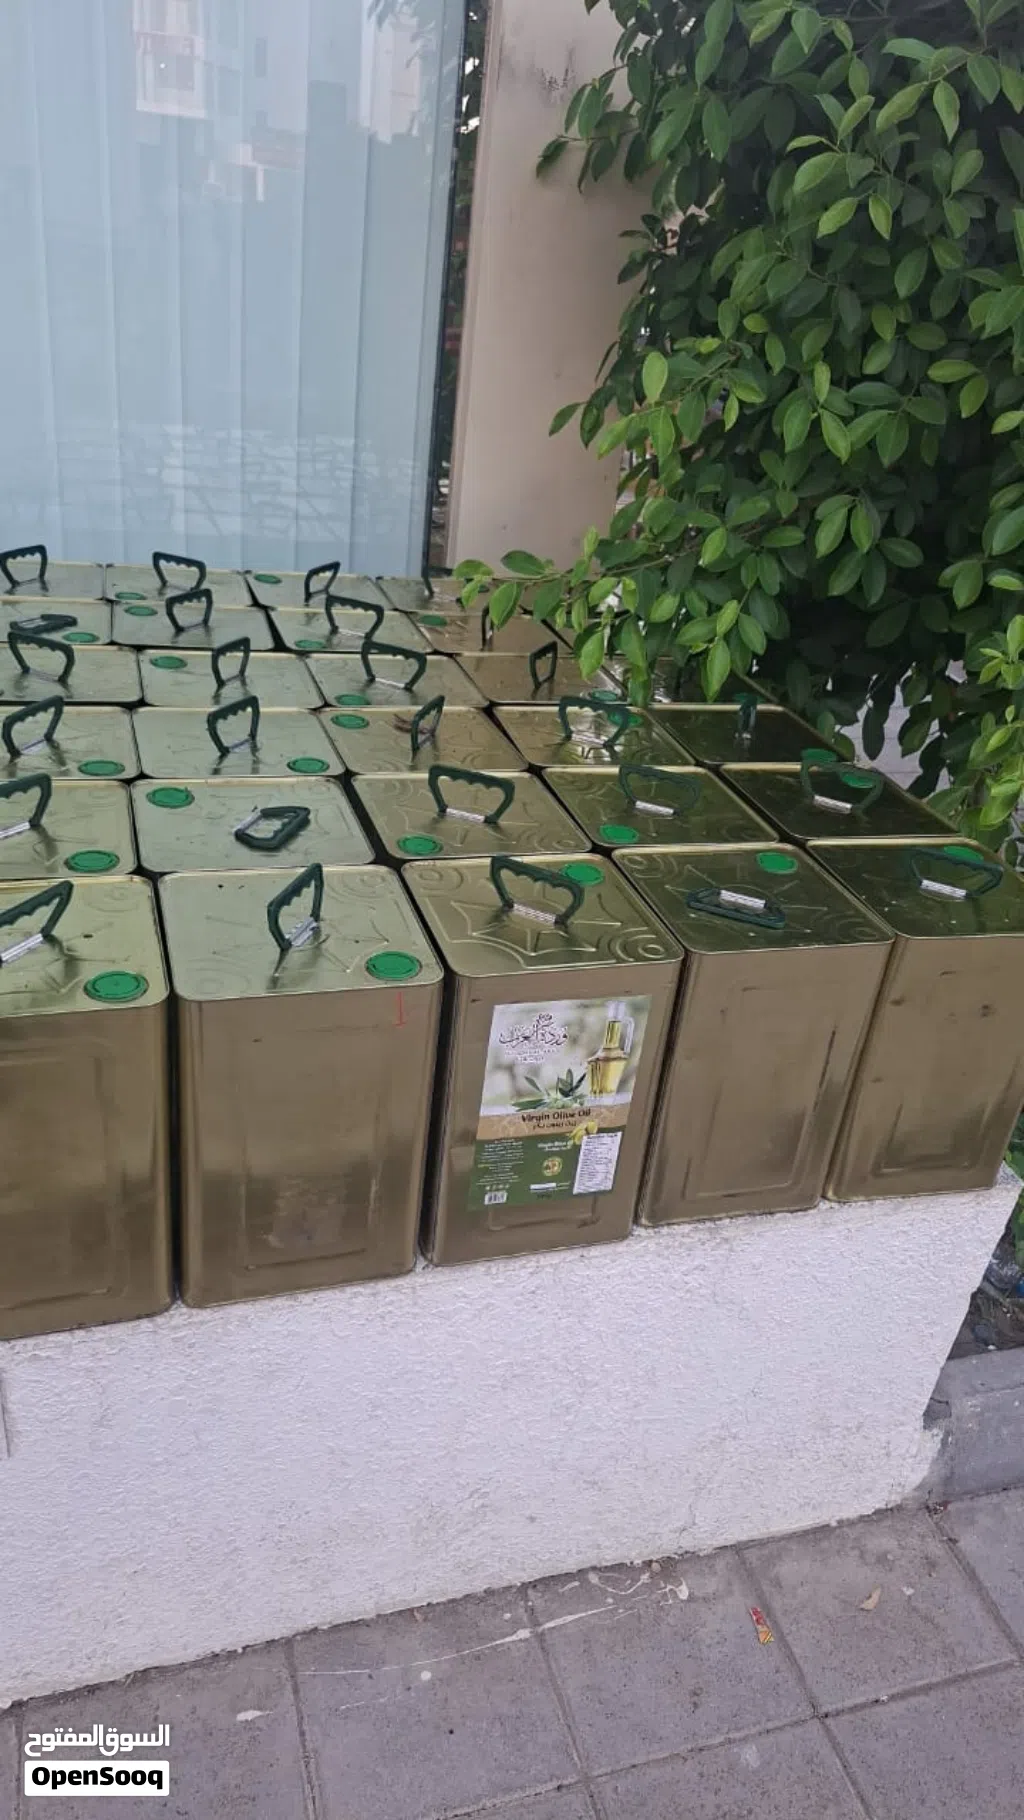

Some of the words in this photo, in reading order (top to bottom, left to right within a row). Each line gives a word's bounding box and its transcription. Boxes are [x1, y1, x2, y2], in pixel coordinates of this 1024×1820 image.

[521, 1112, 550, 1122] Virgin
[552, 1111, 576, 1120] Olive
[578, 1108, 591, 1117] Oil
